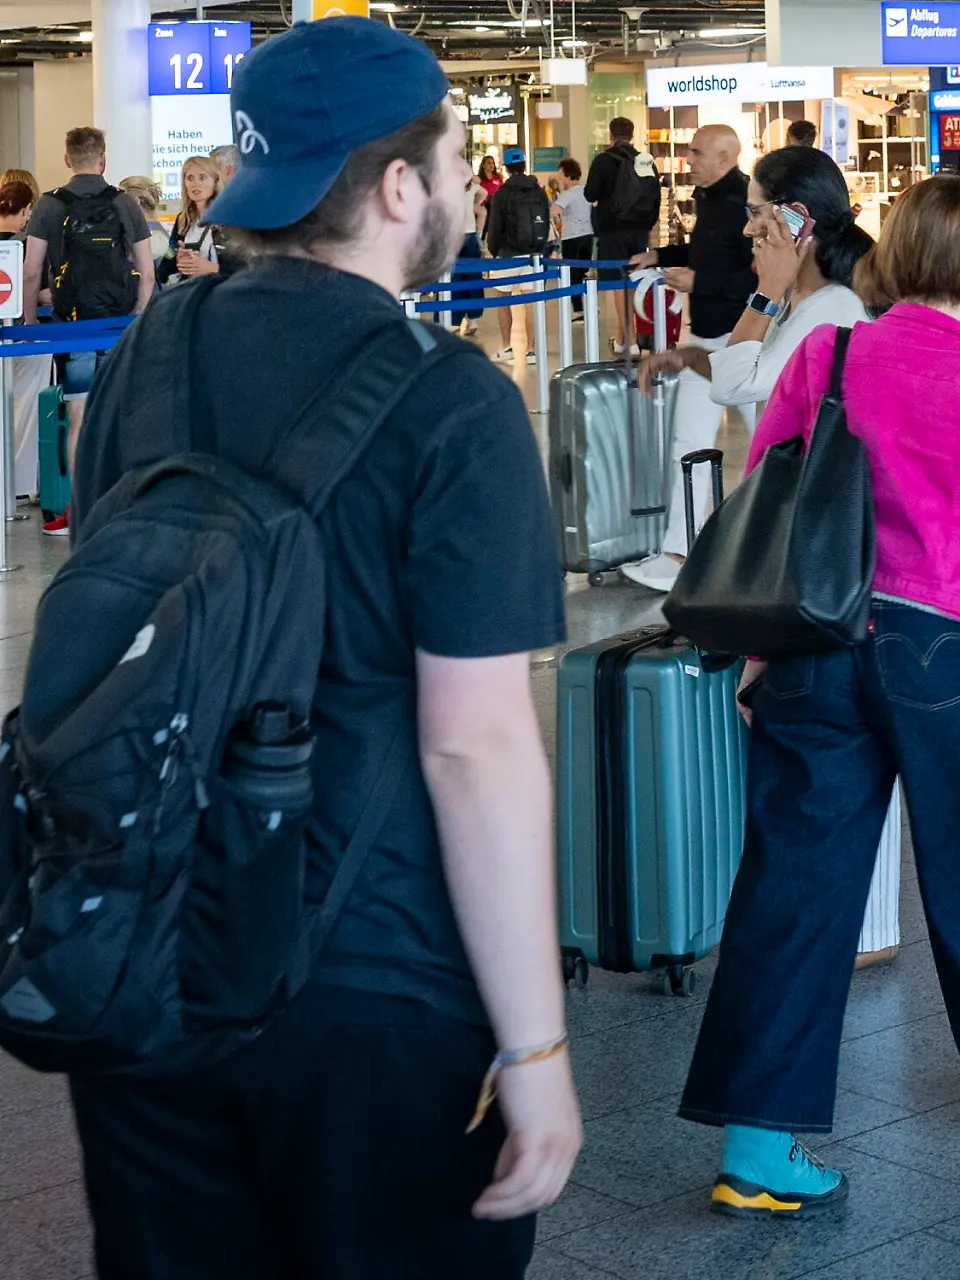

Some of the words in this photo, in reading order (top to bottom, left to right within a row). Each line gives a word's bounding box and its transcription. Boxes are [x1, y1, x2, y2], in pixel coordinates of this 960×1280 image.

[909, 8, 940, 24] Abflug
[910, 24, 957, 39] Departures
[169, 53, 204, 89] 12
[224, 53, 245, 89] 1
[667, 74, 738, 93] worldshop
[770, 79, 806, 88] Lufthansa
[168, 130, 203, 139] Haben
[167, 144, 188, 154] sich
